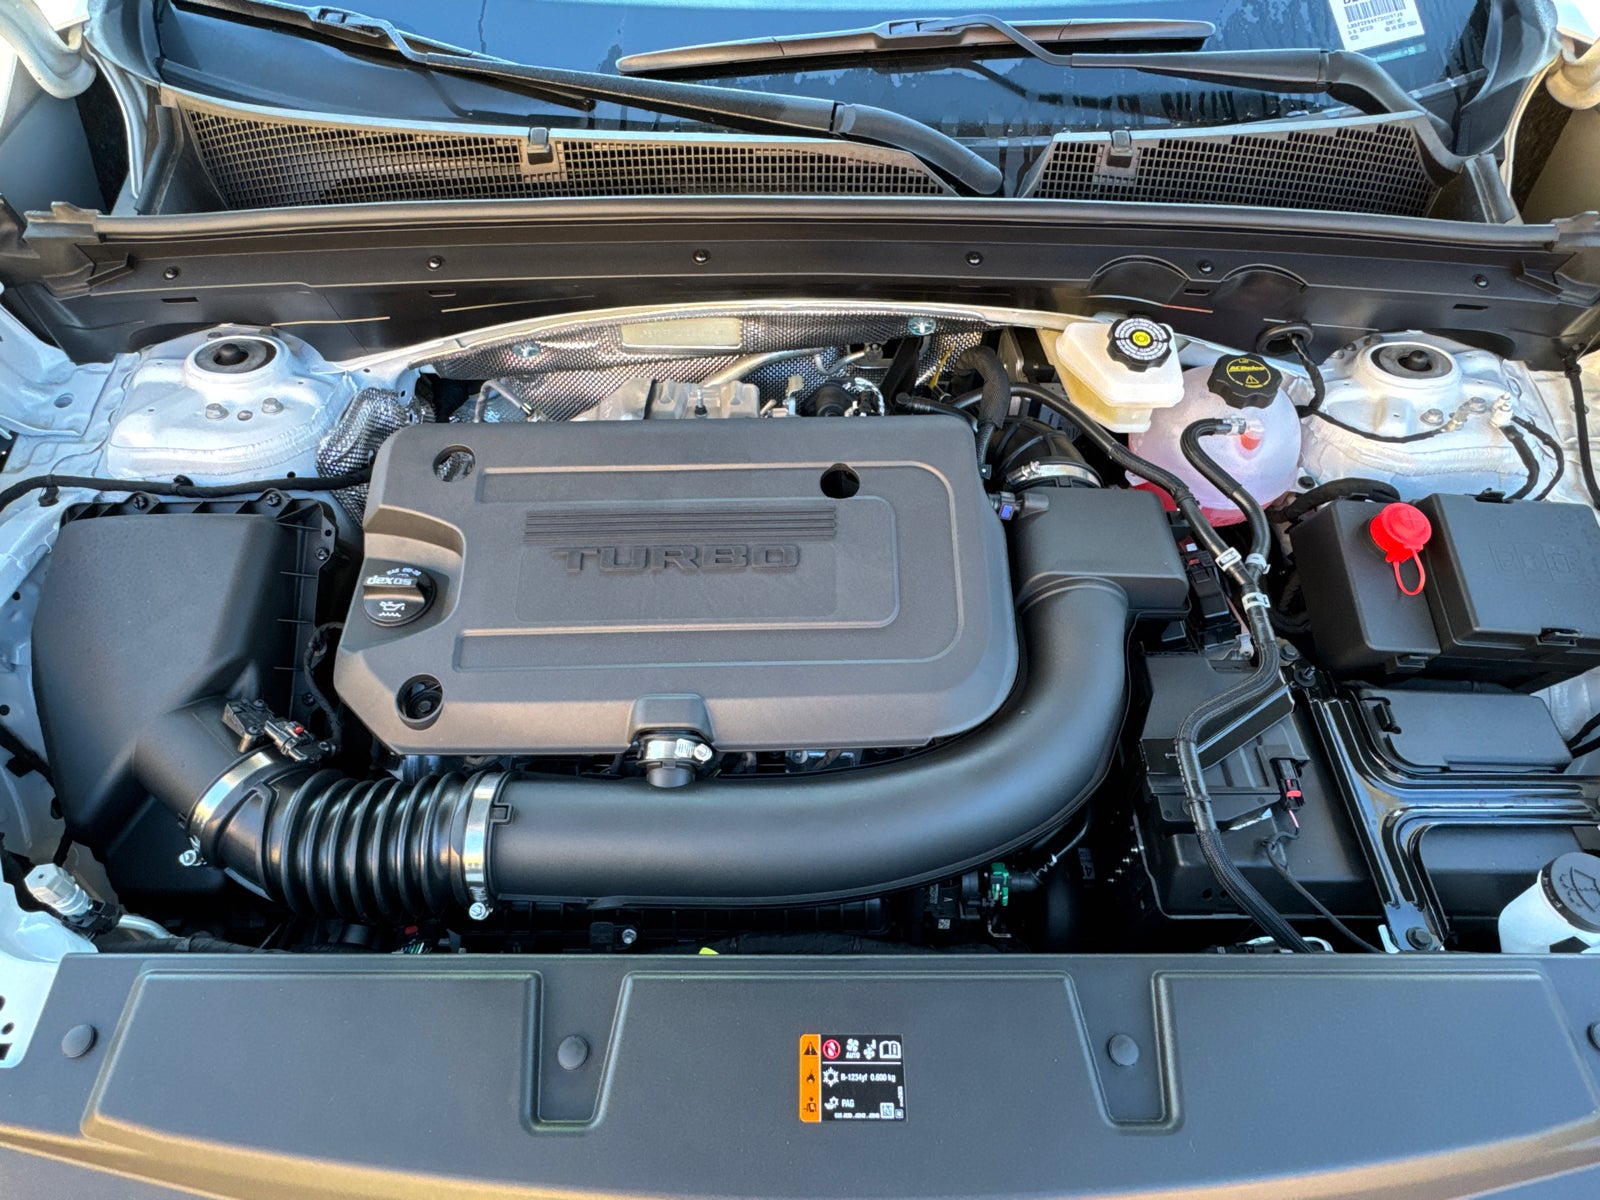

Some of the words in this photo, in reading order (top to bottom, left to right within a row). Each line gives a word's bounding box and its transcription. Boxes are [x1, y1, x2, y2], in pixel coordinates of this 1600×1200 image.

[552, 544, 799, 573] TURBO
[367, 575, 412, 585] dexos
[840, 1073, 868, 1083] R-1234yf
[887, 1073, 896, 1083] kg
[841, 1099, 855, 1108] PAG
